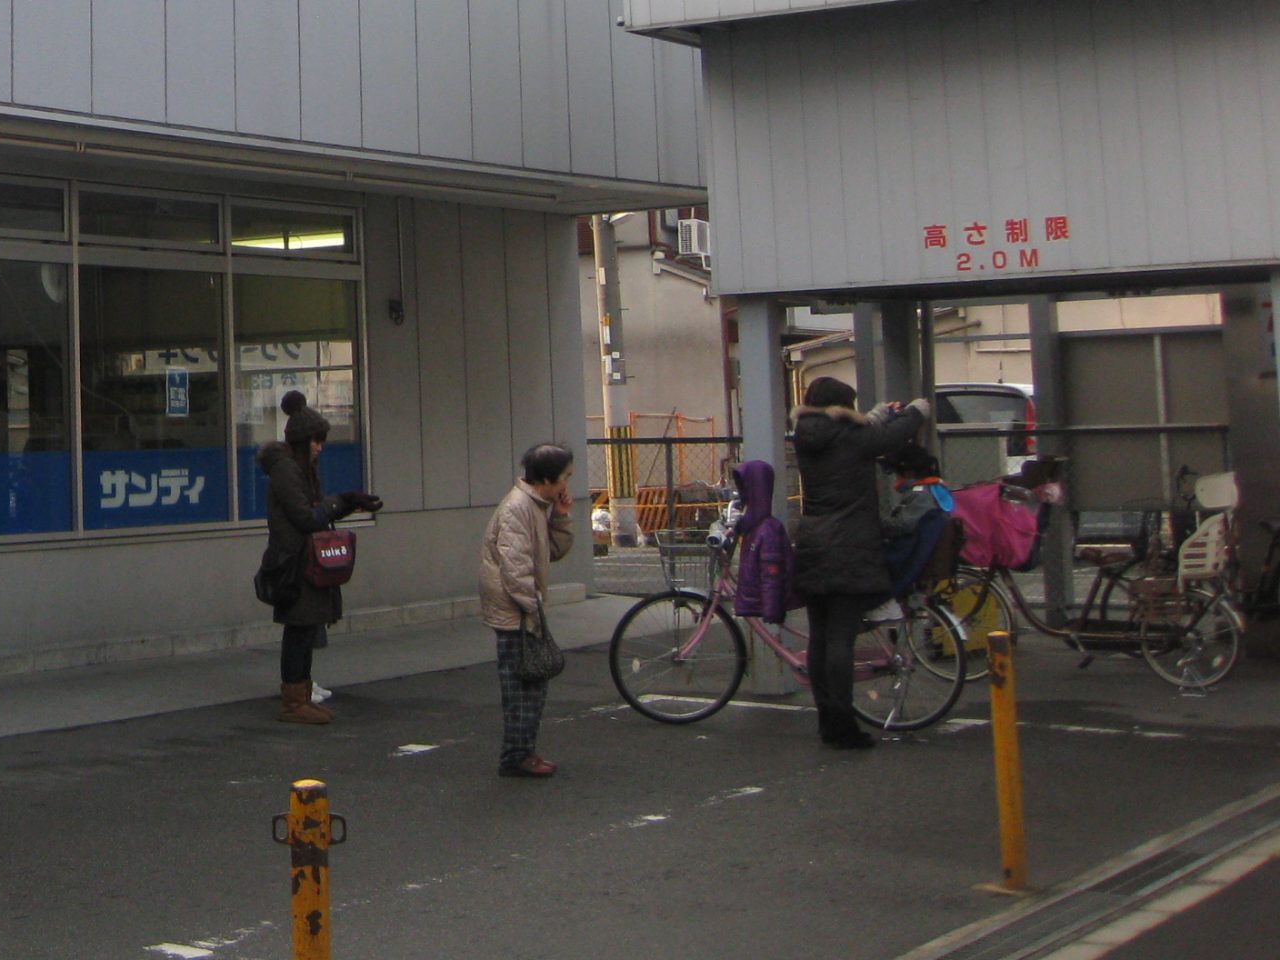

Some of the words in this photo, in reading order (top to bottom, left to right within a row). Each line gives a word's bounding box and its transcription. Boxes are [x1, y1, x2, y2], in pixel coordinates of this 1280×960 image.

[923, 216, 1070, 249] 高さ制限
[100, 469, 205, 509] サンディ
